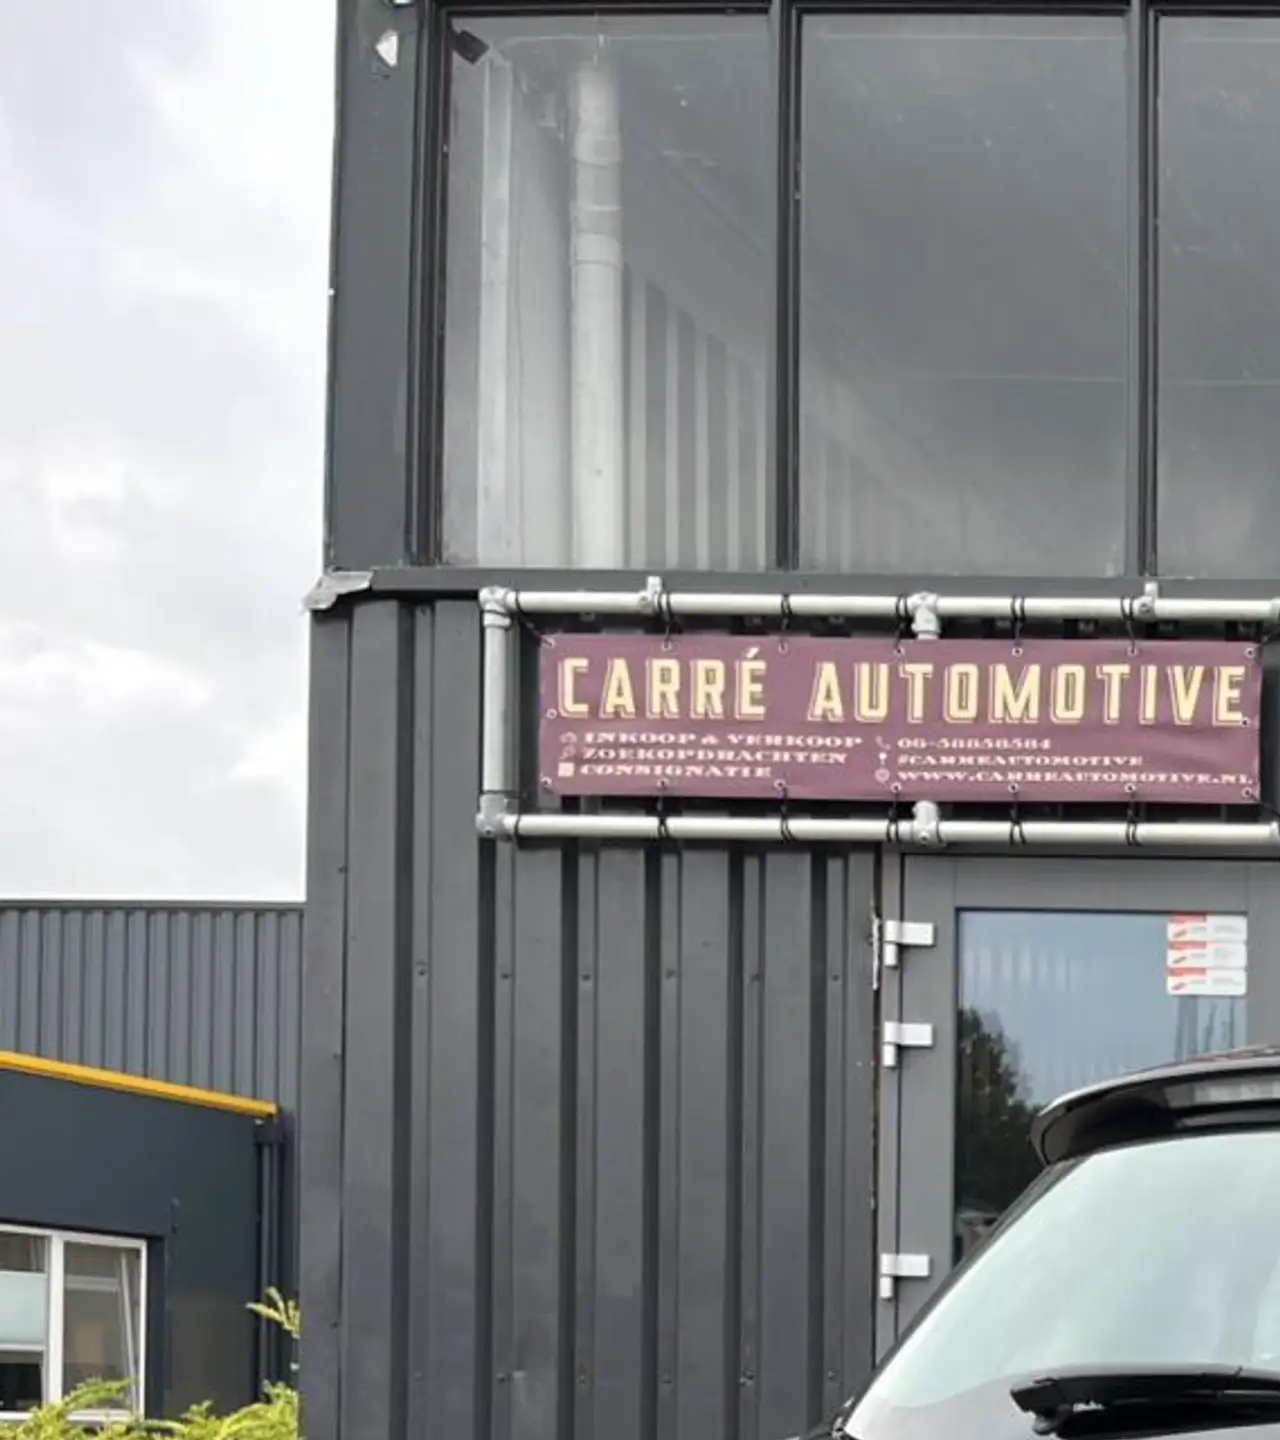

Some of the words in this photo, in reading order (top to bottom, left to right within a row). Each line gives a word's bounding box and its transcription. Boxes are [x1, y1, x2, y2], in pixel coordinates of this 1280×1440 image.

[557, 647, 766, 719] CARRÉ
[807, 662, 1247, 726] AUTOMOTIVE
[583, 733, 696, 745] INKOOP
[728, 734, 863, 748] VERKOOP
[582, 747, 848, 765] ZOEKOPDRACHTEN
